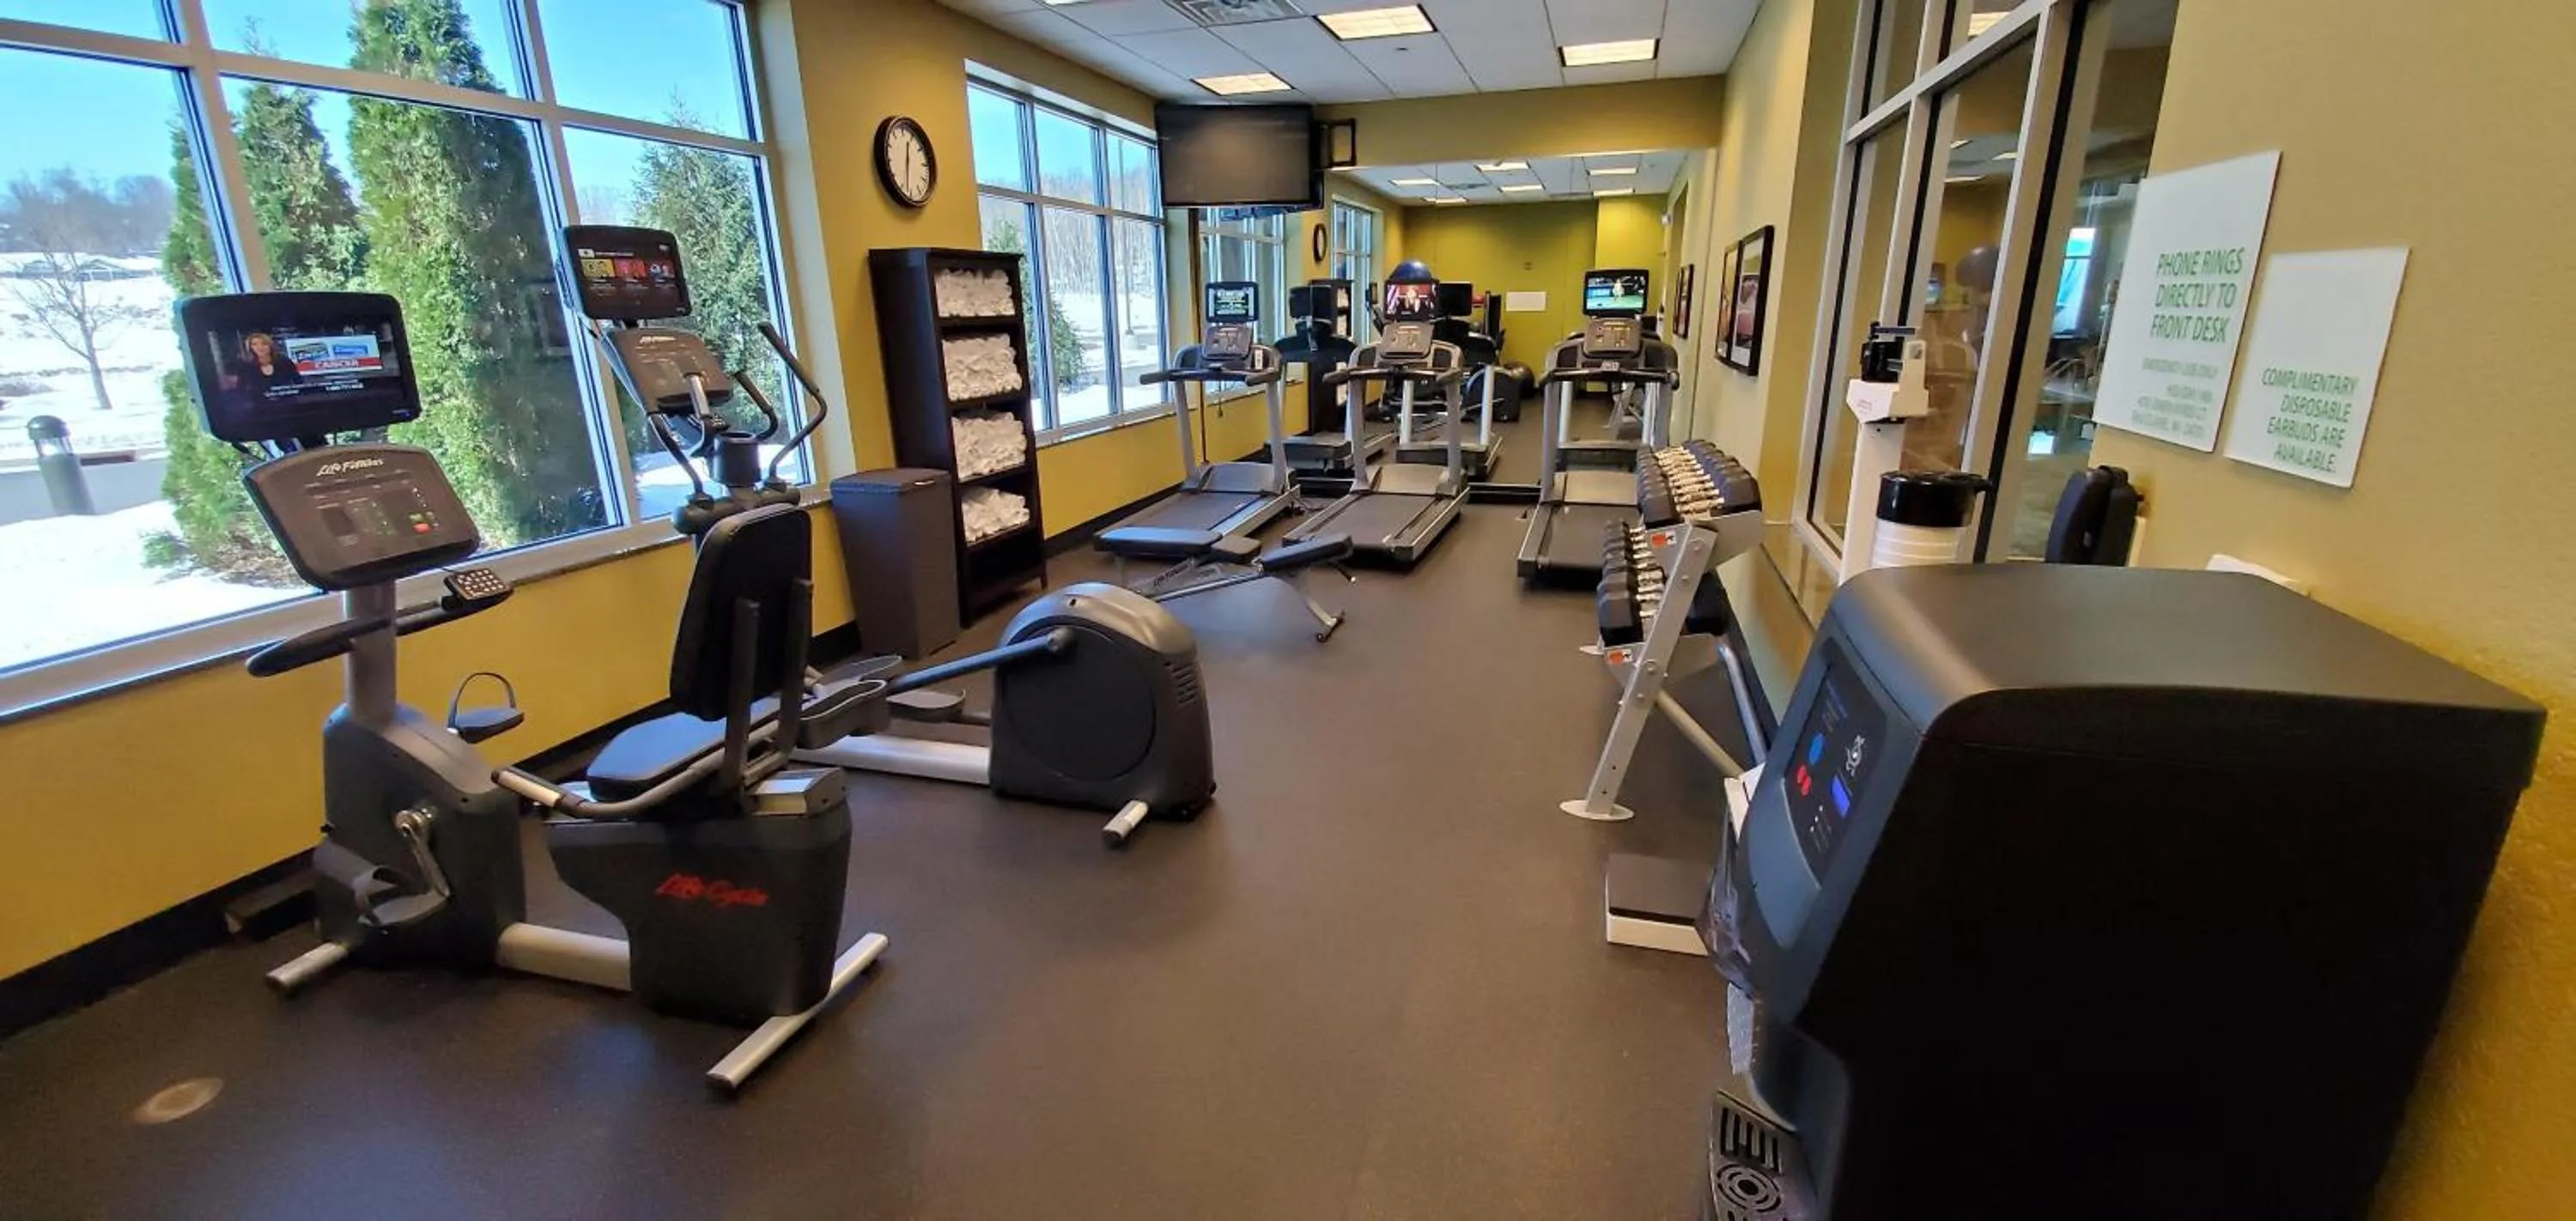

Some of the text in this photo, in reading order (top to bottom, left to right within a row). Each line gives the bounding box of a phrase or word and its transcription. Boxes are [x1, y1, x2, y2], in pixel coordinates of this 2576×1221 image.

[2156, 246, 2245, 276] PHONE RINGS
[2154, 282, 2238, 308] DIRECTLY TO
[2149, 314, 2230, 343] FRONT DESK
[2261, 368, 2360, 395] COMPLIMENTARY
[2280, 394, 2353, 423] DISPOSABLE
[2267, 416, 2346, 448] EARBUDS ARE
[2273, 443, 2337, 473] AVAILABLE.
